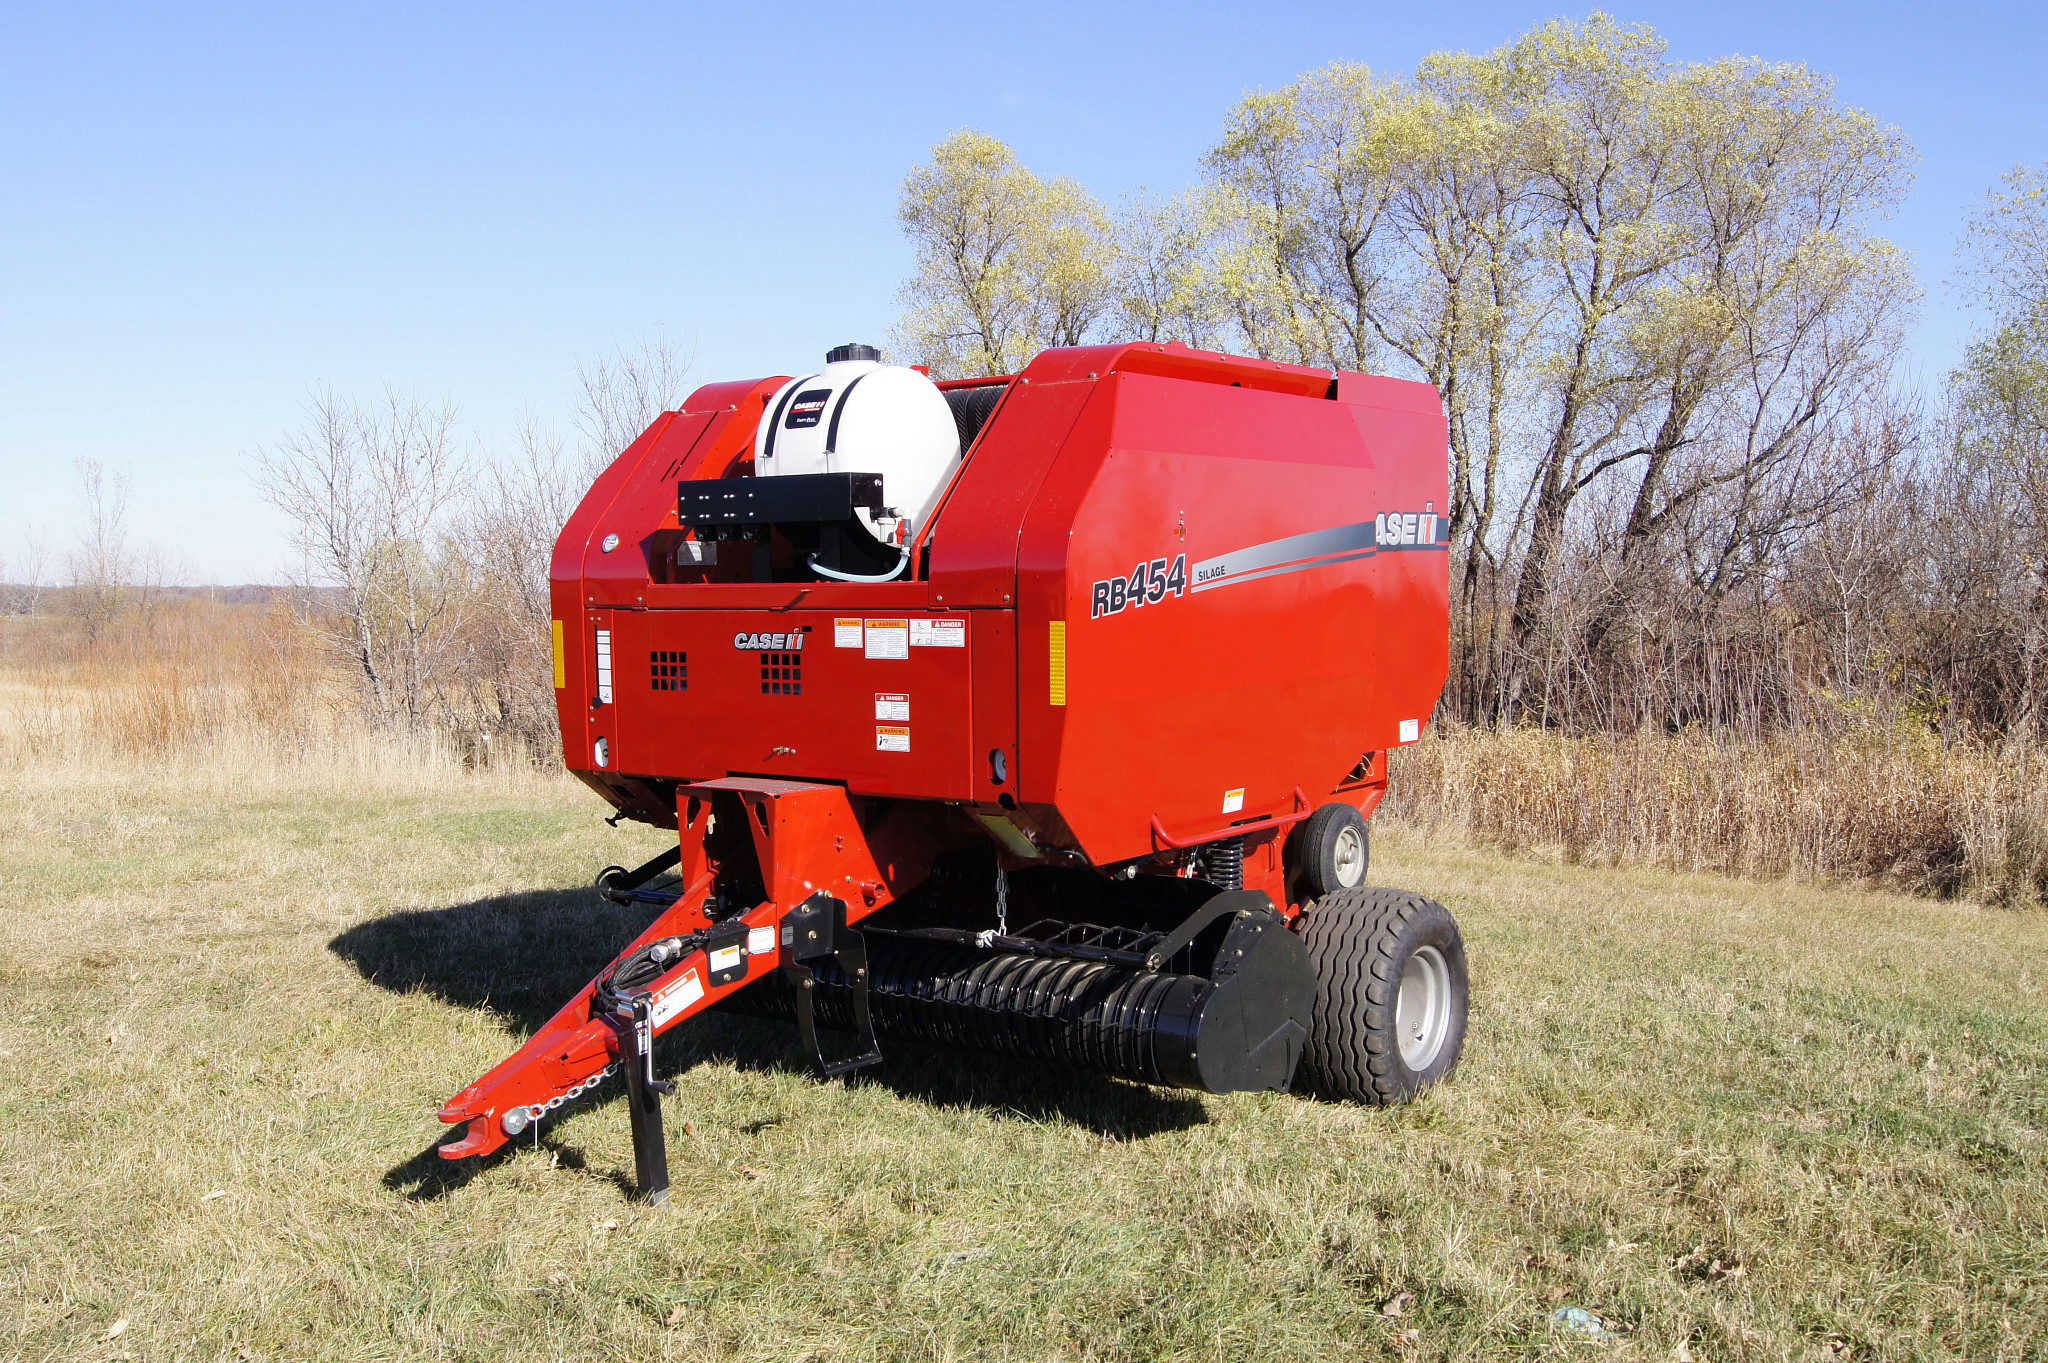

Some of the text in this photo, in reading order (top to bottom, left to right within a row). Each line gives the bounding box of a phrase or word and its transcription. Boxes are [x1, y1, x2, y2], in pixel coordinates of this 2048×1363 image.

[794, 402, 817, 410] CASE
[1198, 565, 1226, 582] SILAGE
[1091, 553, 1186, 620] RB454
[734, 632, 786, 650] CASE
[665, 977, 688, 996] DANGER
